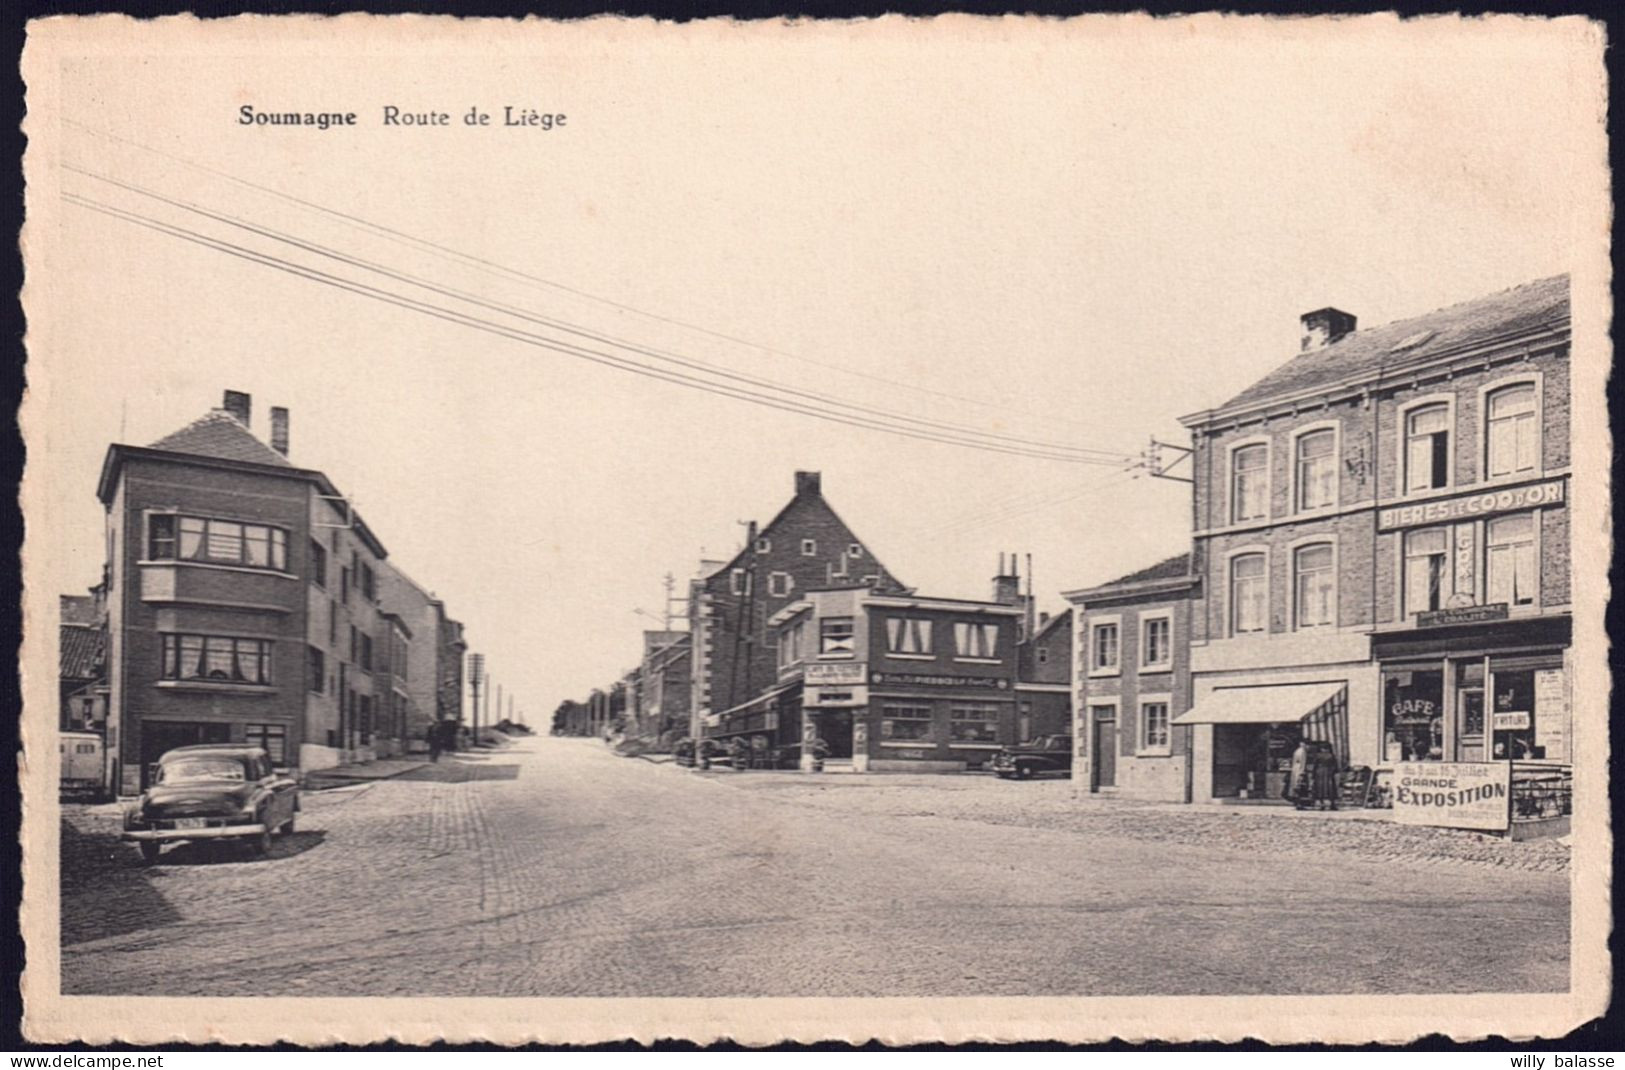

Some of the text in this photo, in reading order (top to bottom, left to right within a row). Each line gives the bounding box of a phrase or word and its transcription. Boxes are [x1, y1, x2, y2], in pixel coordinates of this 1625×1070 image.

[1382, 501, 1449, 527] BIERES
[1467, 491, 1513, 513] COQ
[1450, 765, 1489, 778] Juillet
[1401, 777, 1458, 789] GRANDE
[1396, 783, 1506, 807] EXPOSITION
